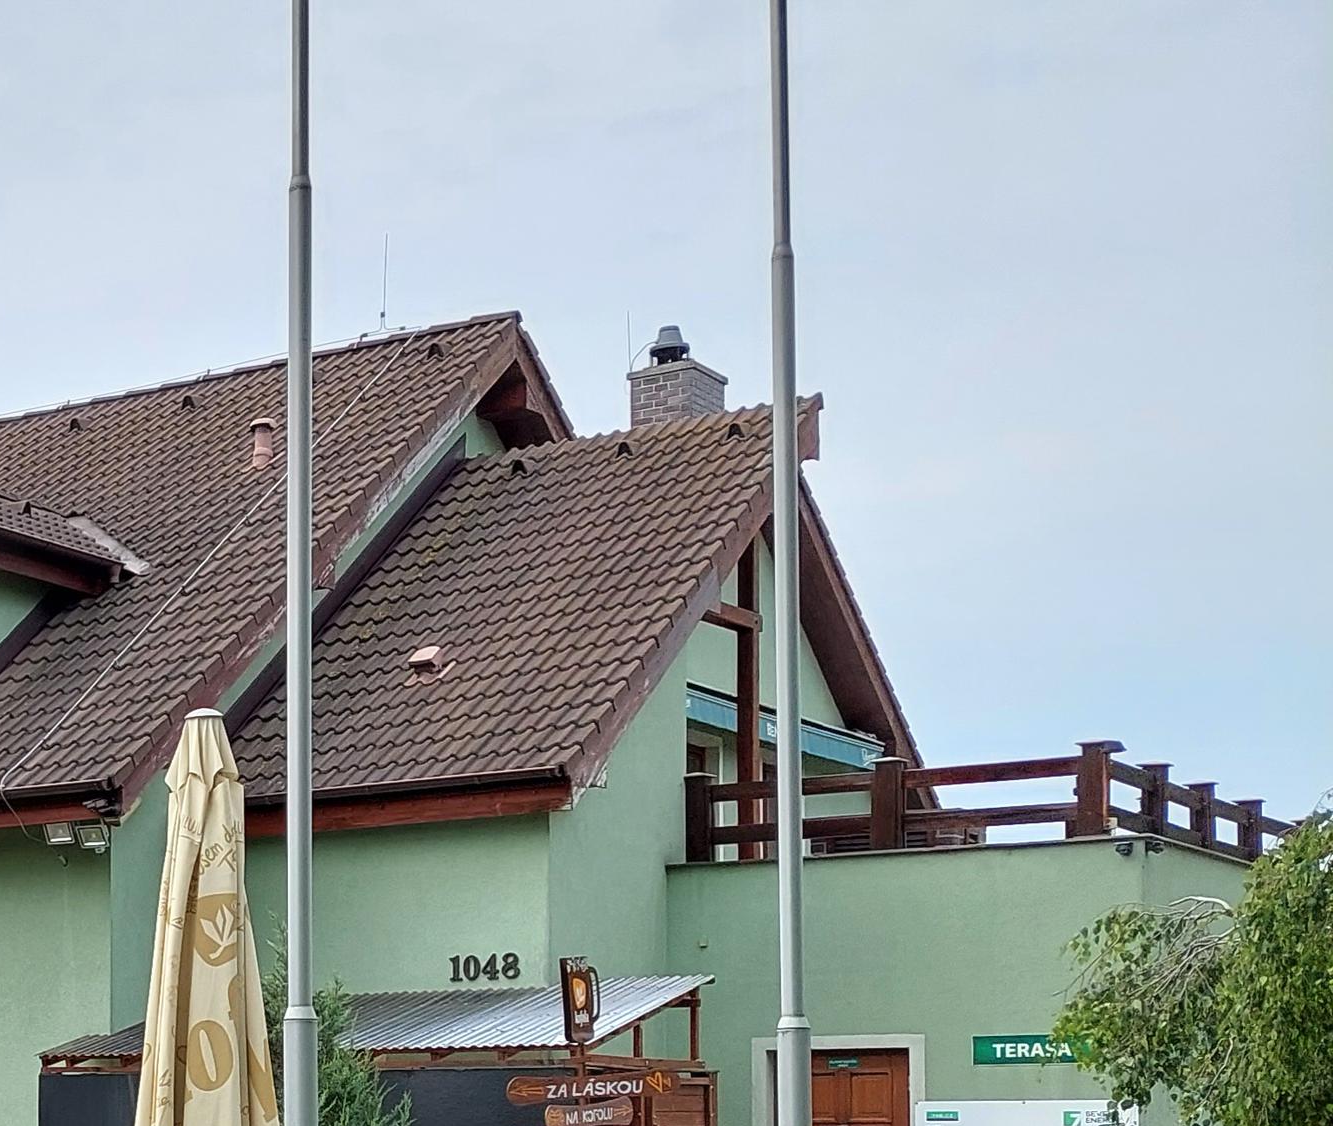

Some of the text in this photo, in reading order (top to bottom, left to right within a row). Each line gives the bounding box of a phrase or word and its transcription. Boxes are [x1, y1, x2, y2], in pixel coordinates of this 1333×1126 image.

[449, 952, 521, 982] 1048
[546, 1078, 644, 1099] ZA LÁSKOU
[565, 1111, 579, 1126] NA
